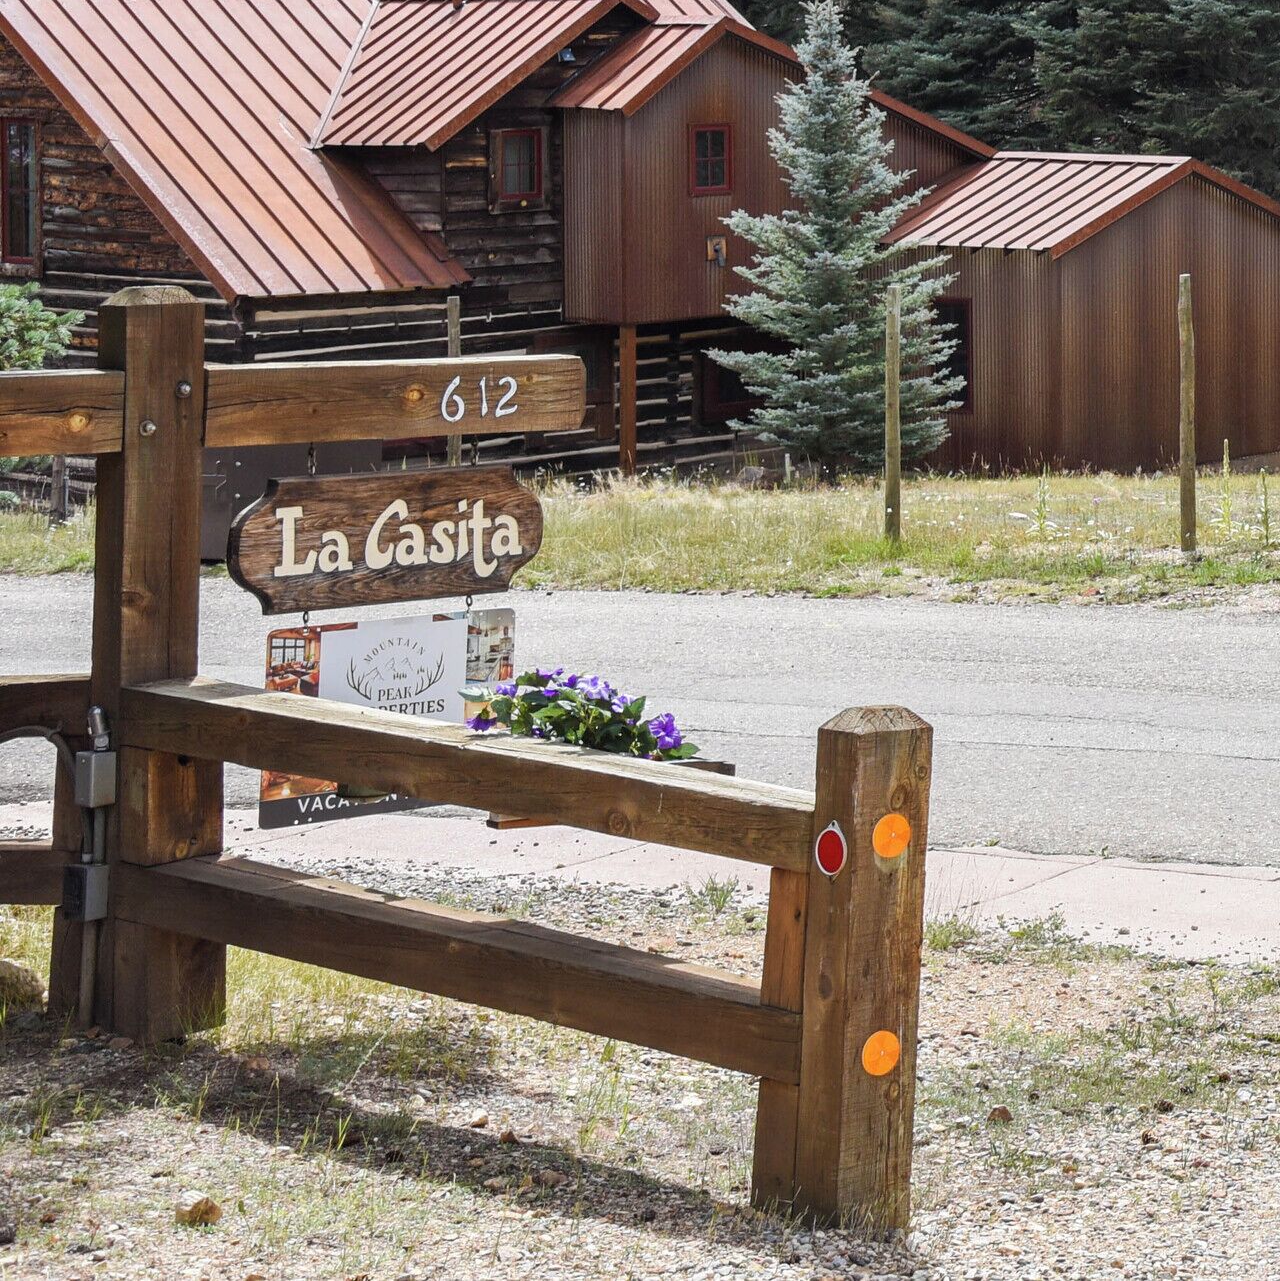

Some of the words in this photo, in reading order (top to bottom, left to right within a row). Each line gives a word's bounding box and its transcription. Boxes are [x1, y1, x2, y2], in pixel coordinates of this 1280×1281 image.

[440, 375, 519, 423] 612
[273, 505, 353, 578] La
[364, 498, 523, 578] Casita
[363, 637, 426, 664] MOUNTAIN
[377, 686, 412, 702] PEAK
